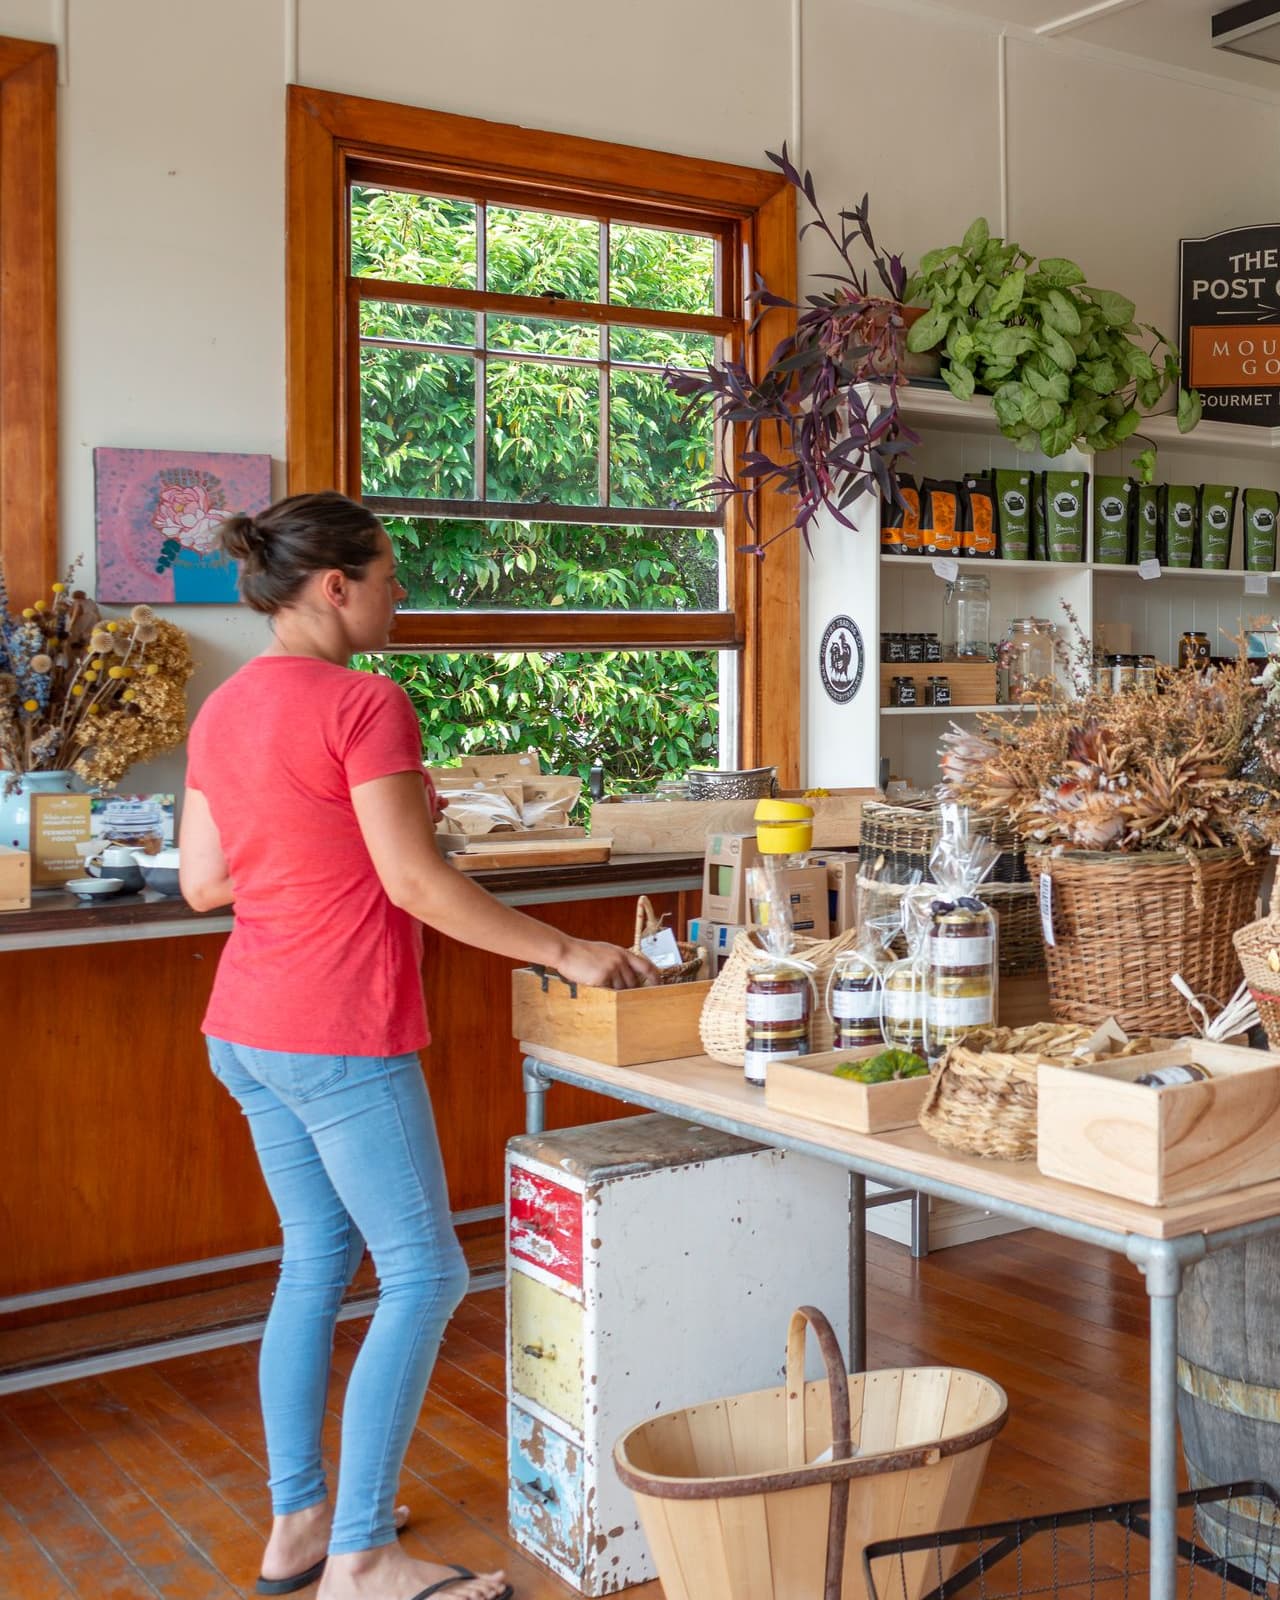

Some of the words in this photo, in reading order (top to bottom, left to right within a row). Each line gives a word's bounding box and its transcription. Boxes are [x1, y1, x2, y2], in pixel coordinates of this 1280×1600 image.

[1229, 248, 1279, 274] THE
[1192, 278, 1266, 300] POST
[1199, 393, 1272, 407] GOURMET
